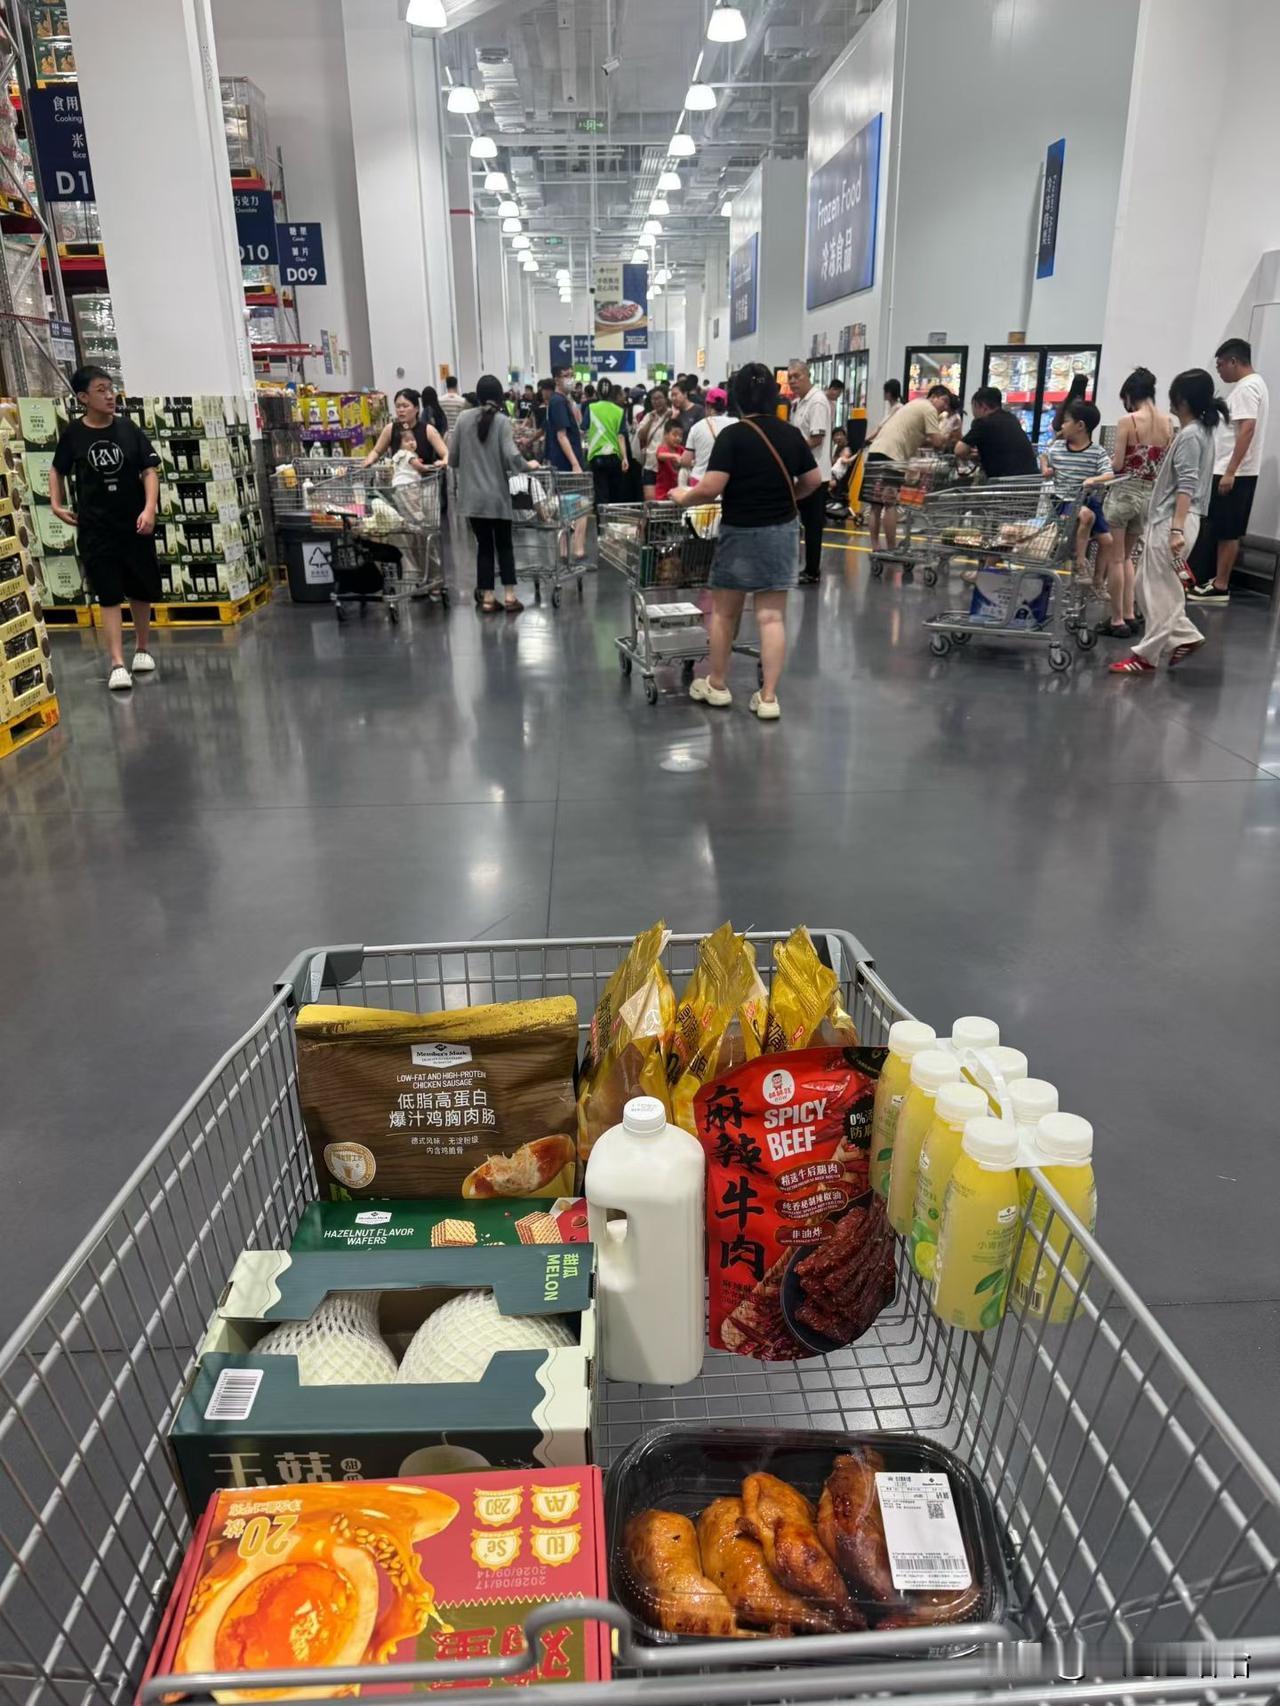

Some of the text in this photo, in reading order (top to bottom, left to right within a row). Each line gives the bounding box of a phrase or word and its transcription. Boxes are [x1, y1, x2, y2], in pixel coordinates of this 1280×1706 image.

[53, 96, 79, 111] 食用
[54, 114, 83, 124] Cooking
[72, 133, 84, 148] 米
[72, 150, 87, 159] Rice
[817, 164, 862, 230] Frozen Food
[821, 227, 852, 281] 冷冻食品
[286, 268, 318, 282] D09
[396, 1070, 486, 1082] LOW-FAT AND HIGH-PROTEIN
[413, 1079, 473, 1089] CHICKEN SAUSAGE
[397, 1089, 487, 1110] 低脂高蛋白
[389, 1107, 496, 1128] 爆汁鸡胸肉肠
[763, 1097, 828, 1129] SPICY
[766, 1125, 817, 1162] BEEF
[703, 1084, 769, 1283] 麻辣牛肉
[781, 1163, 838, 1186] 精选牛后腿肉
[324, 1227, 415, 1238] HAZELNUT FLAVOR
[347, 1236, 387, 1245] WAFERS
[792, 1226, 822, 1239] 非油炸
[563, 1253, 579, 1279] 甜瓜
[544, 1254, 561, 1301] MELON
[222, 1514, 299, 1558] 20枚
[546, 1535, 566, 1555] EU
